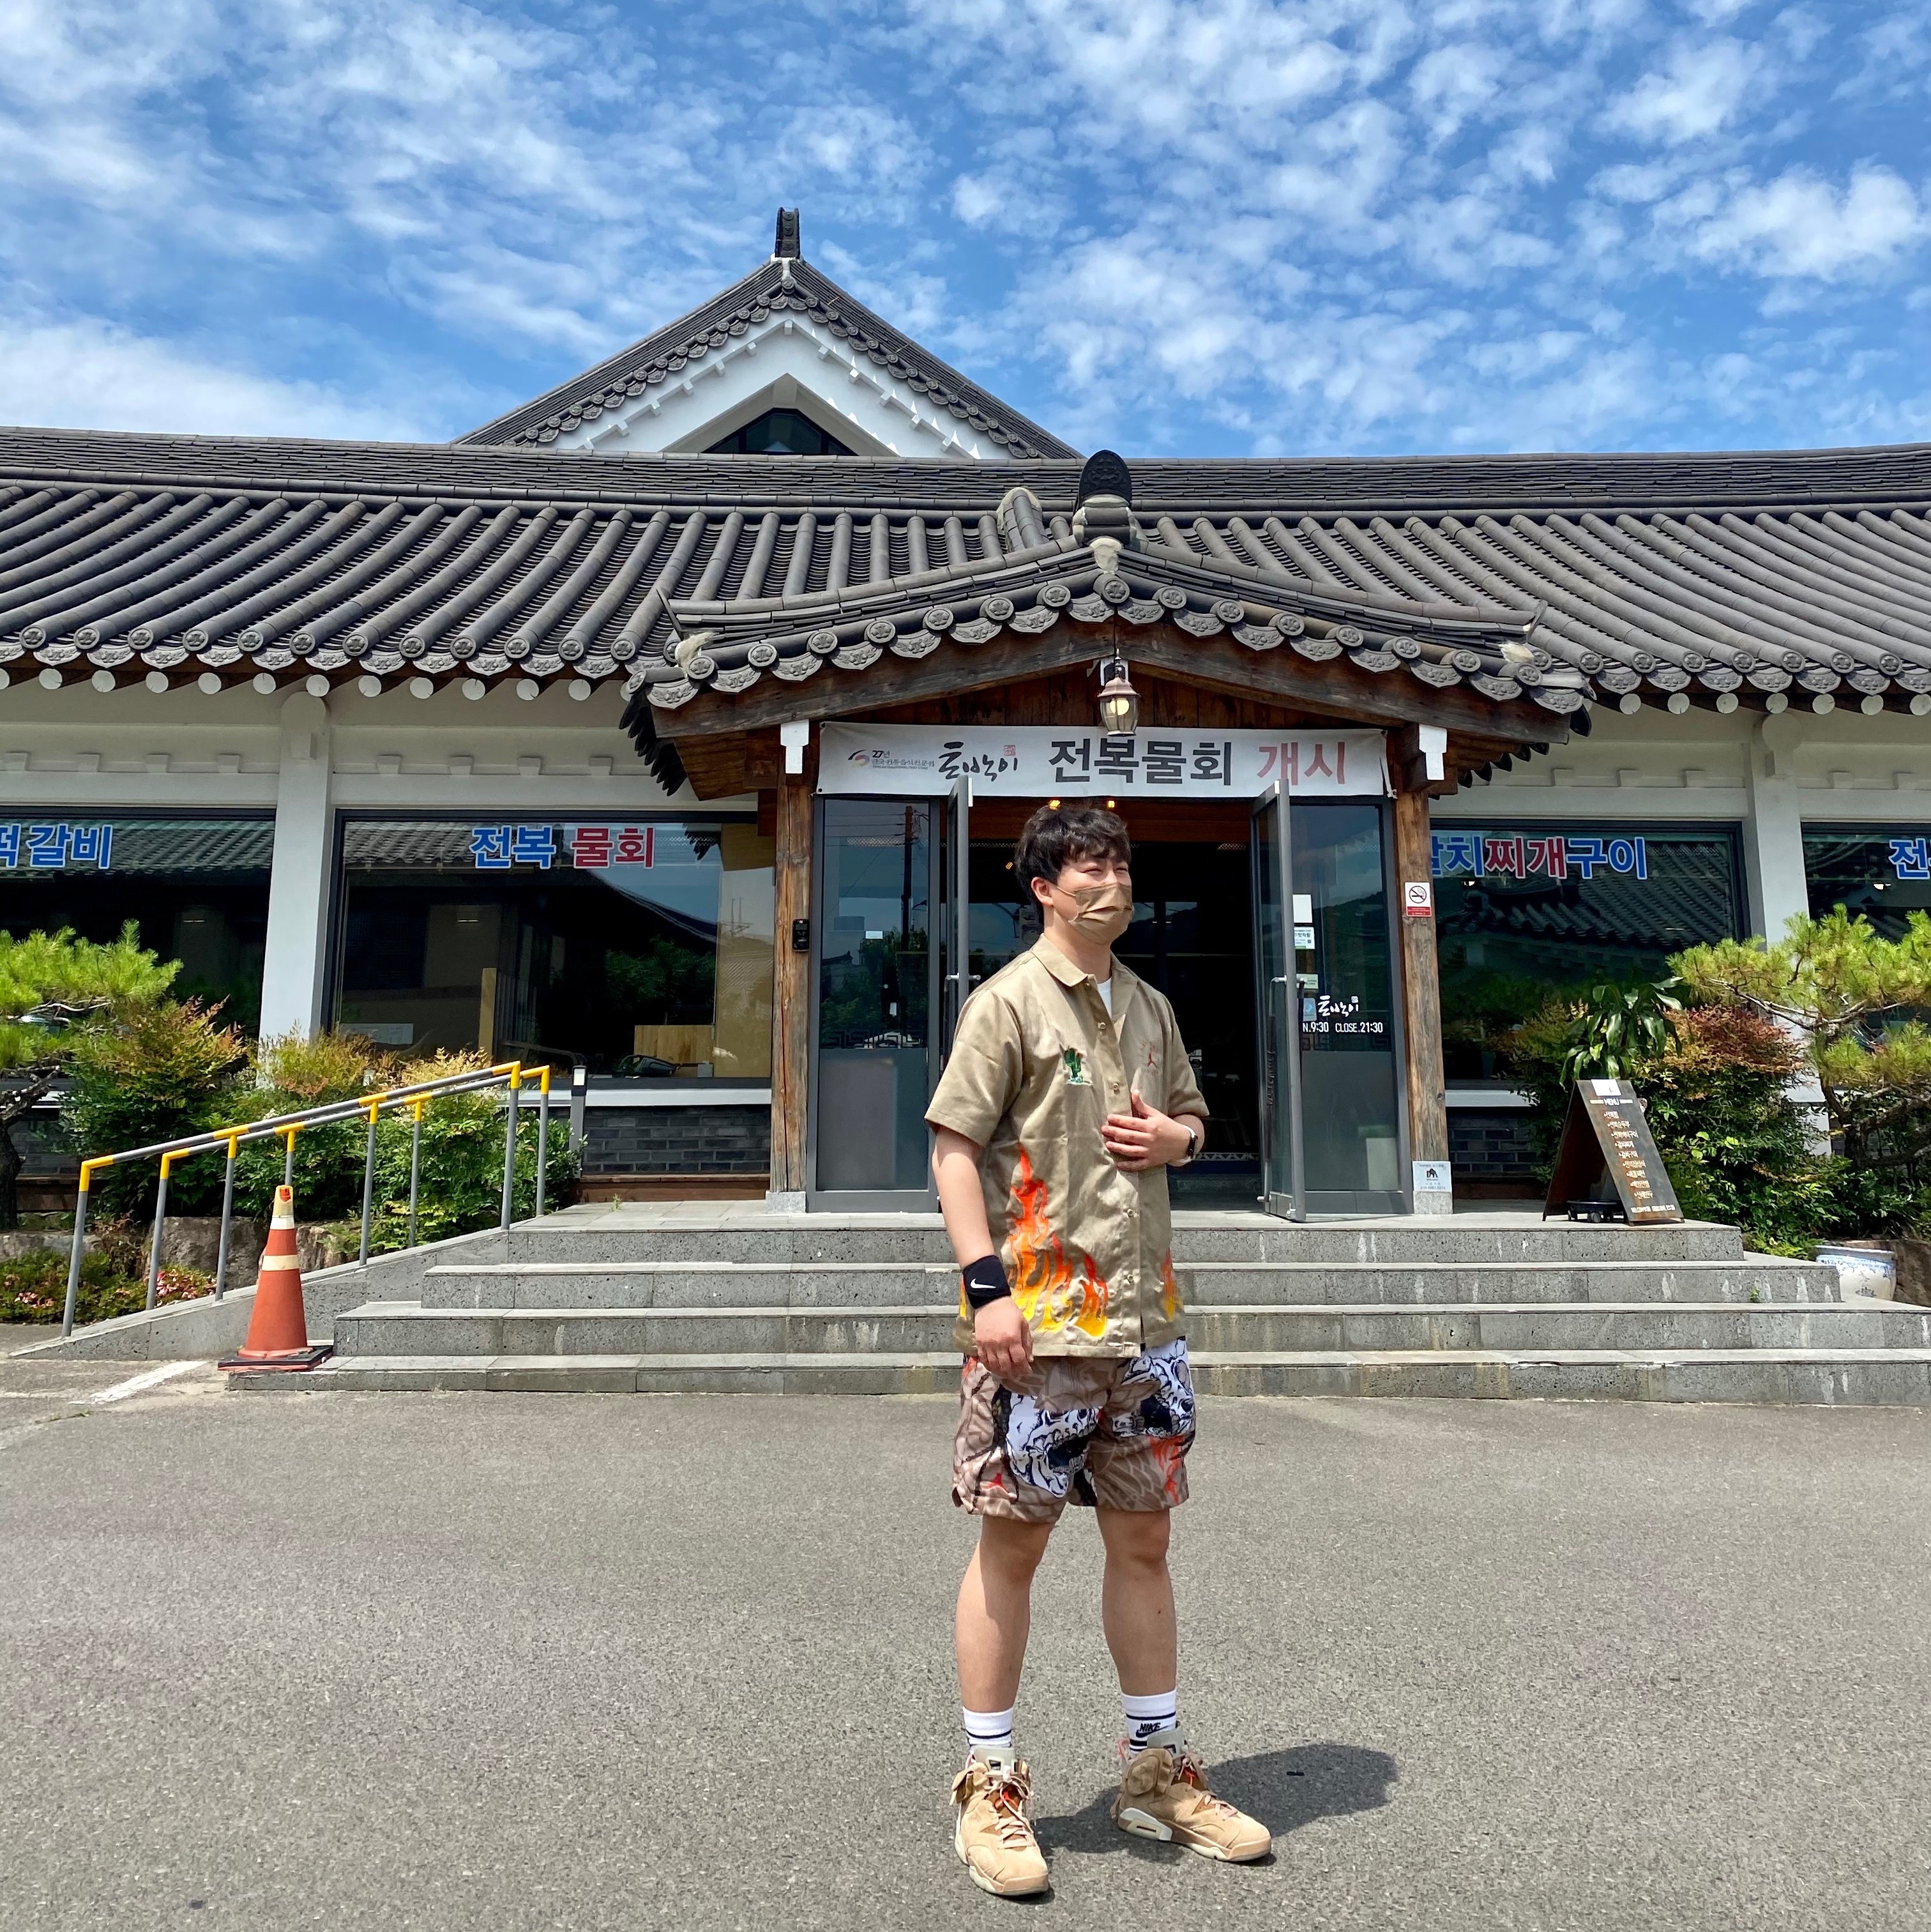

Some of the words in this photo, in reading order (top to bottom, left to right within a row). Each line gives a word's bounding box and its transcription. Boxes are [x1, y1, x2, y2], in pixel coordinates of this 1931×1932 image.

[1048, 738, 1231, 786] 전복물회
[1256, 742, 1345, 786] 개시
[469, 825, 556, 869] 전복
[570, 826, 655, 869] 물회
[1888, 838, 1931, 879] 전
[1303, 1022, 1329, 1033] N.9:30
[1139, 1723, 1161, 1732] NIKE
